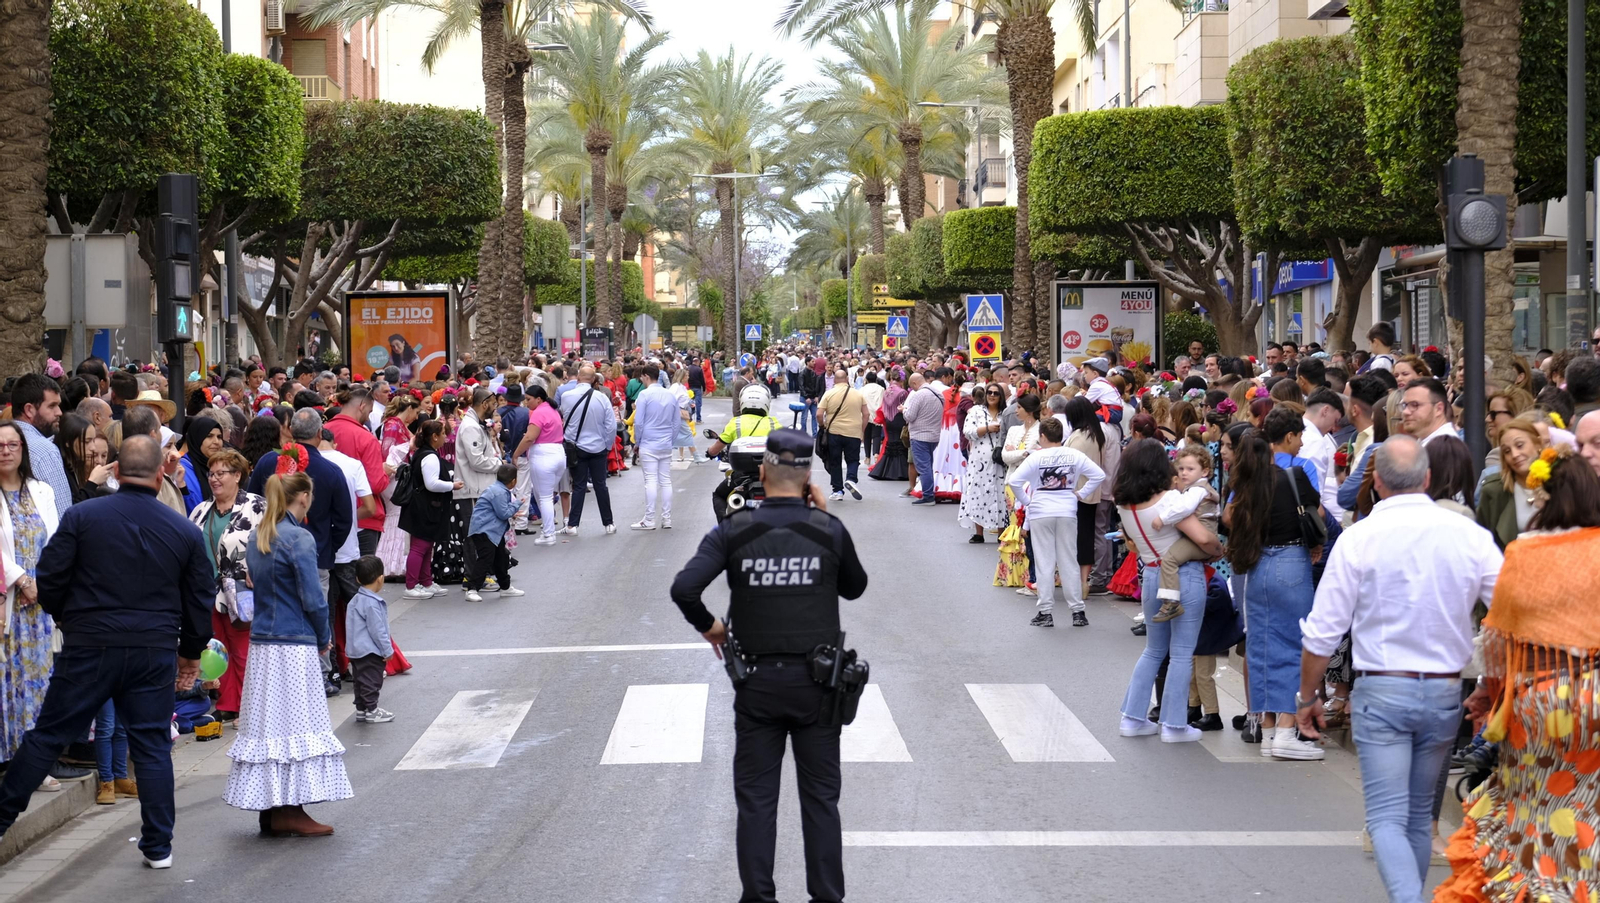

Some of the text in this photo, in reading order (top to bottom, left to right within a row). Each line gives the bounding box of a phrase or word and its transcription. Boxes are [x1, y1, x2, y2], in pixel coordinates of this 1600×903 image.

[1121, 289, 1152, 300] MENÚ
[1121, 301, 1152, 310] 4YOU
[362, 306, 434, 320] EL EJIDO
[741, 556, 820, 572] POLICIA
[748, 571, 814, 586] LOCAL
